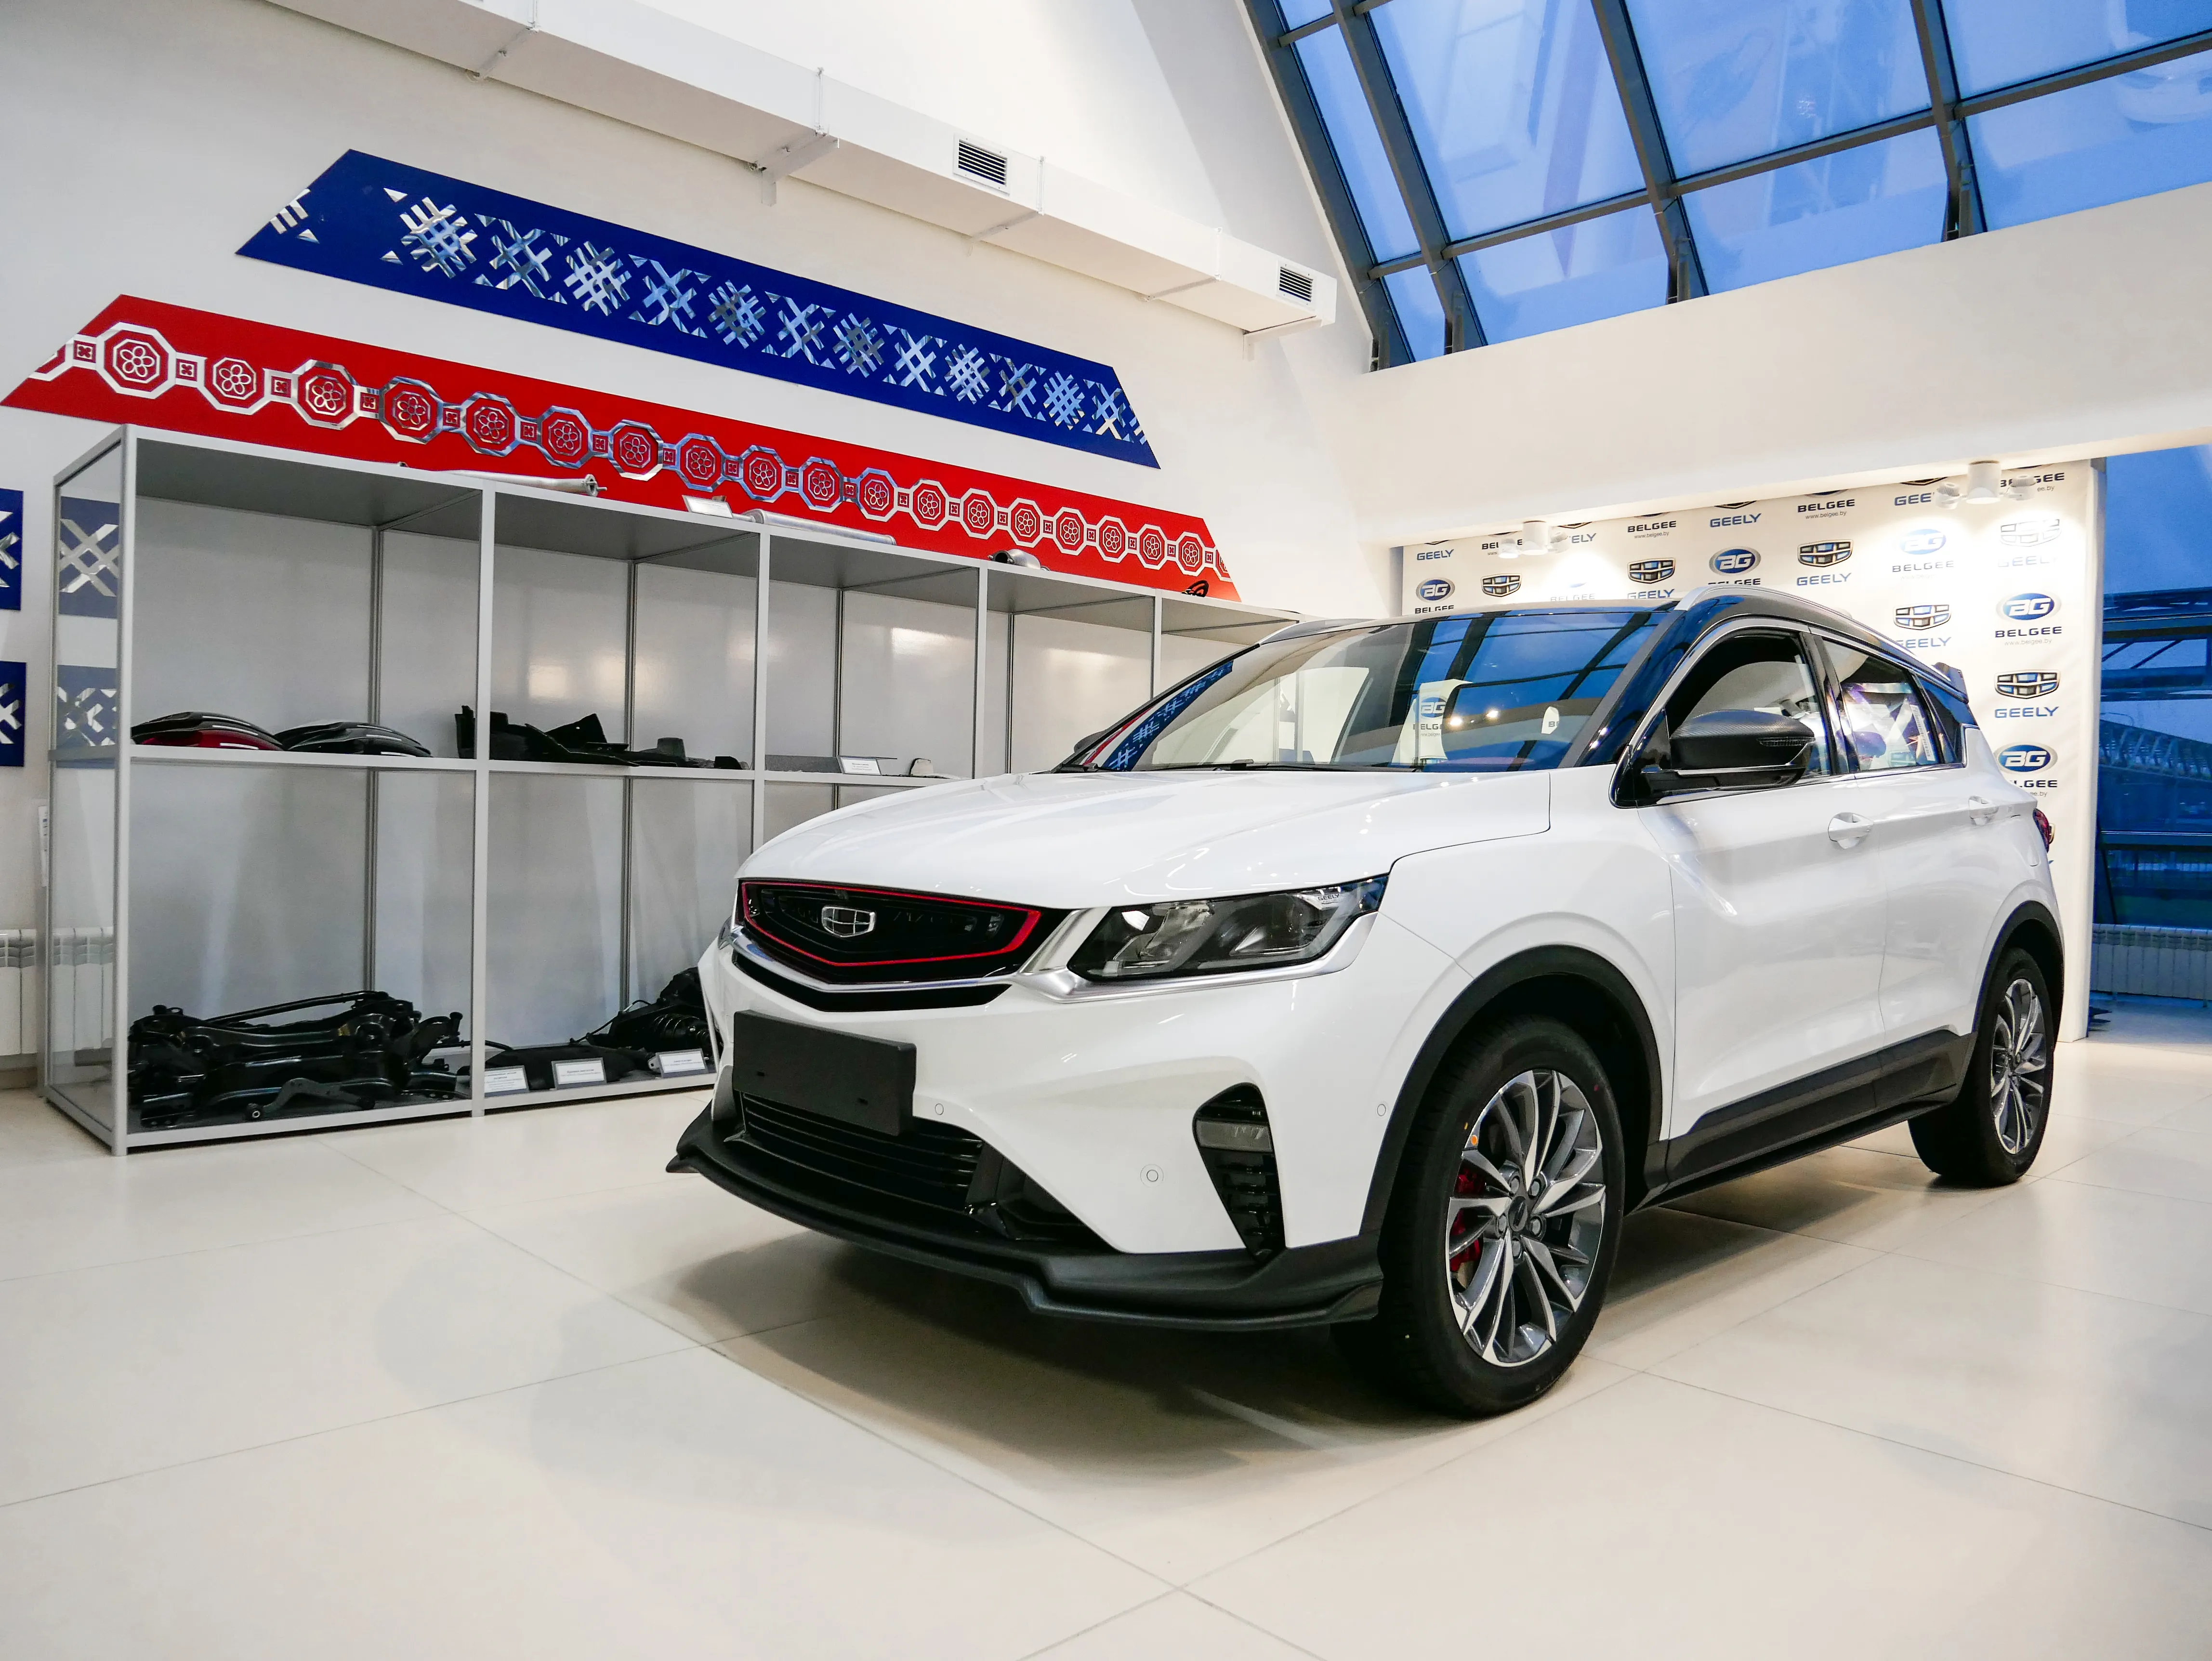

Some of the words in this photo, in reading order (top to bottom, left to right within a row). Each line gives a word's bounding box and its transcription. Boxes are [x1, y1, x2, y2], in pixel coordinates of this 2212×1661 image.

[1895, 492, 1935, 506] GEE
[1797, 499, 1855, 513] BELGEE
[1710, 513, 1762, 527] GEELY
[1805, 511, 1847, 519] www.belgee.by
[1627, 521, 1676, 533] BELGEE
[1569, 533, 1597, 543] ELY
[1634, 531, 1670, 539] www.belgee.by
[1417, 549, 1454, 561] GEELY
[1892, 560, 1954, 572] BELGEE
[1797, 572, 1852, 586] GEELY
[1627, 589, 1675, 600] GEELY
[1995, 627, 2062, 638] BELGEE
[1995, 706, 2059, 718] GEELY
